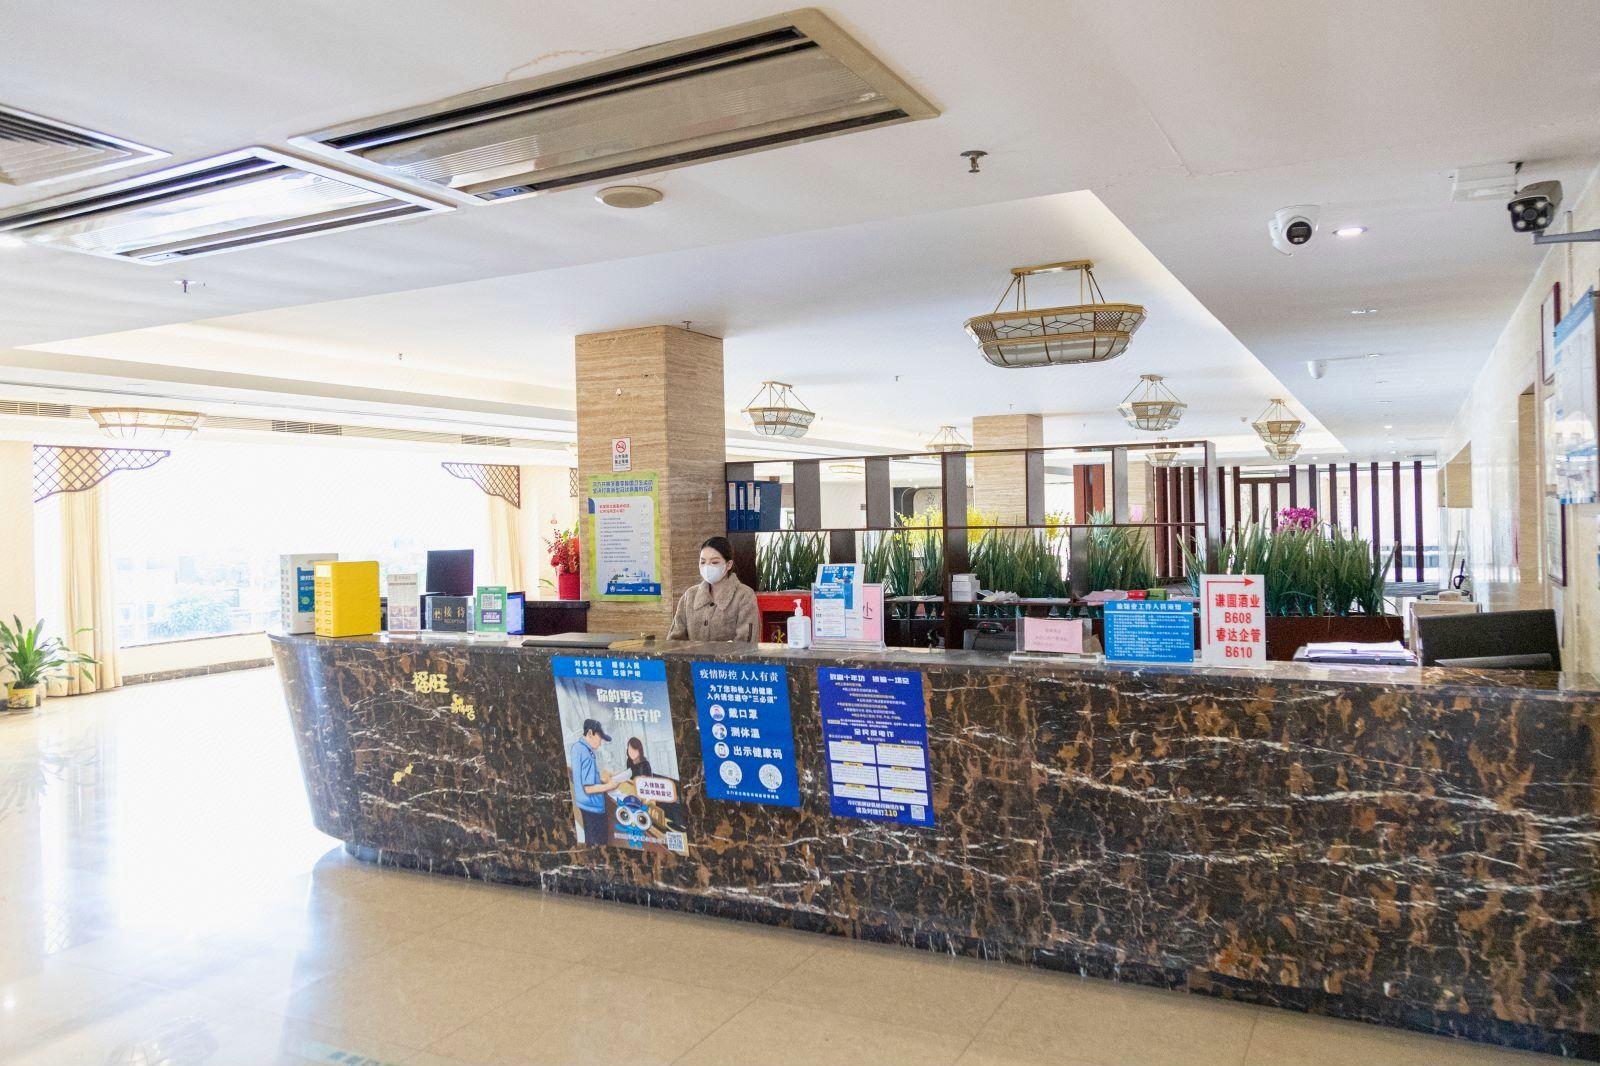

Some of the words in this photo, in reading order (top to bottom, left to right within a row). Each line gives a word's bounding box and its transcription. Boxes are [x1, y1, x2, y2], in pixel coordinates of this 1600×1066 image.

[1224, 612, 1252, 624] B608
[1225, 646, 1253, 658] B610
[612, 661, 640, 669] 服务人民
[613, 670, 641, 678] 纪律严明
[700, 669, 737, 680] 疫情防控
[741, 670, 779, 683] 人人有责
[596, 688, 644, 704] 你的平安
[709, 684, 773, 695] 为了您和他人的健康
[614, 706, 661, 723] 我们守护
[728, 707, 758, 720] 戴口罩
[731, 726, 761, 739] 测体温
[733, 745, 783, 760] 出示健康码
